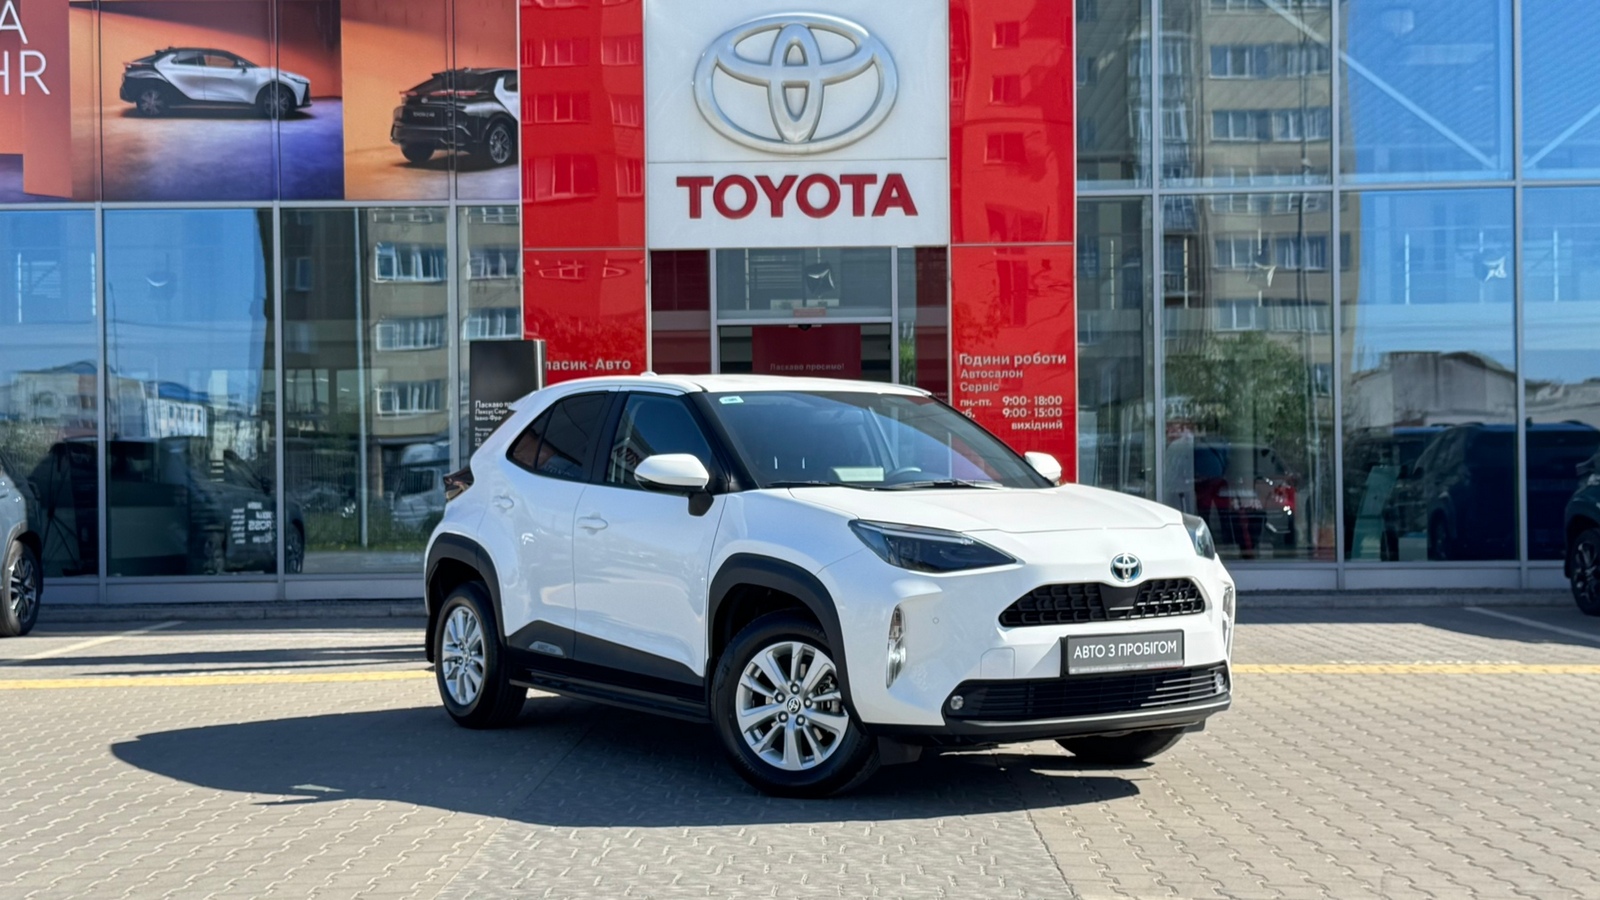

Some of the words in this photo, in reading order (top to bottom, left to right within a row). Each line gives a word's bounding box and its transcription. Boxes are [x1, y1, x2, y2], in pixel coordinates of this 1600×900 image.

[676, 173, 918, 219] TOYOTA
[959, 353, 1010, 366] Години
[1014, 352, 1067, 368] роботи
[769, 363, 804, 371] Ласкаво
[806, 363, 845, 372] просимо!
[960, 369, 1024, 379] Автосалон
[960, 381, 1000, 394] Сервіс
[1034, 395, 1063, 406] 18:00
[1034, 407, 1063, 418] 15:00
[1011, 419, 1063, 430] вихідний
[1073, 644, 1106, 659] АВТО
[1118, 640, 1177, 657] ПРОБІГОМ
